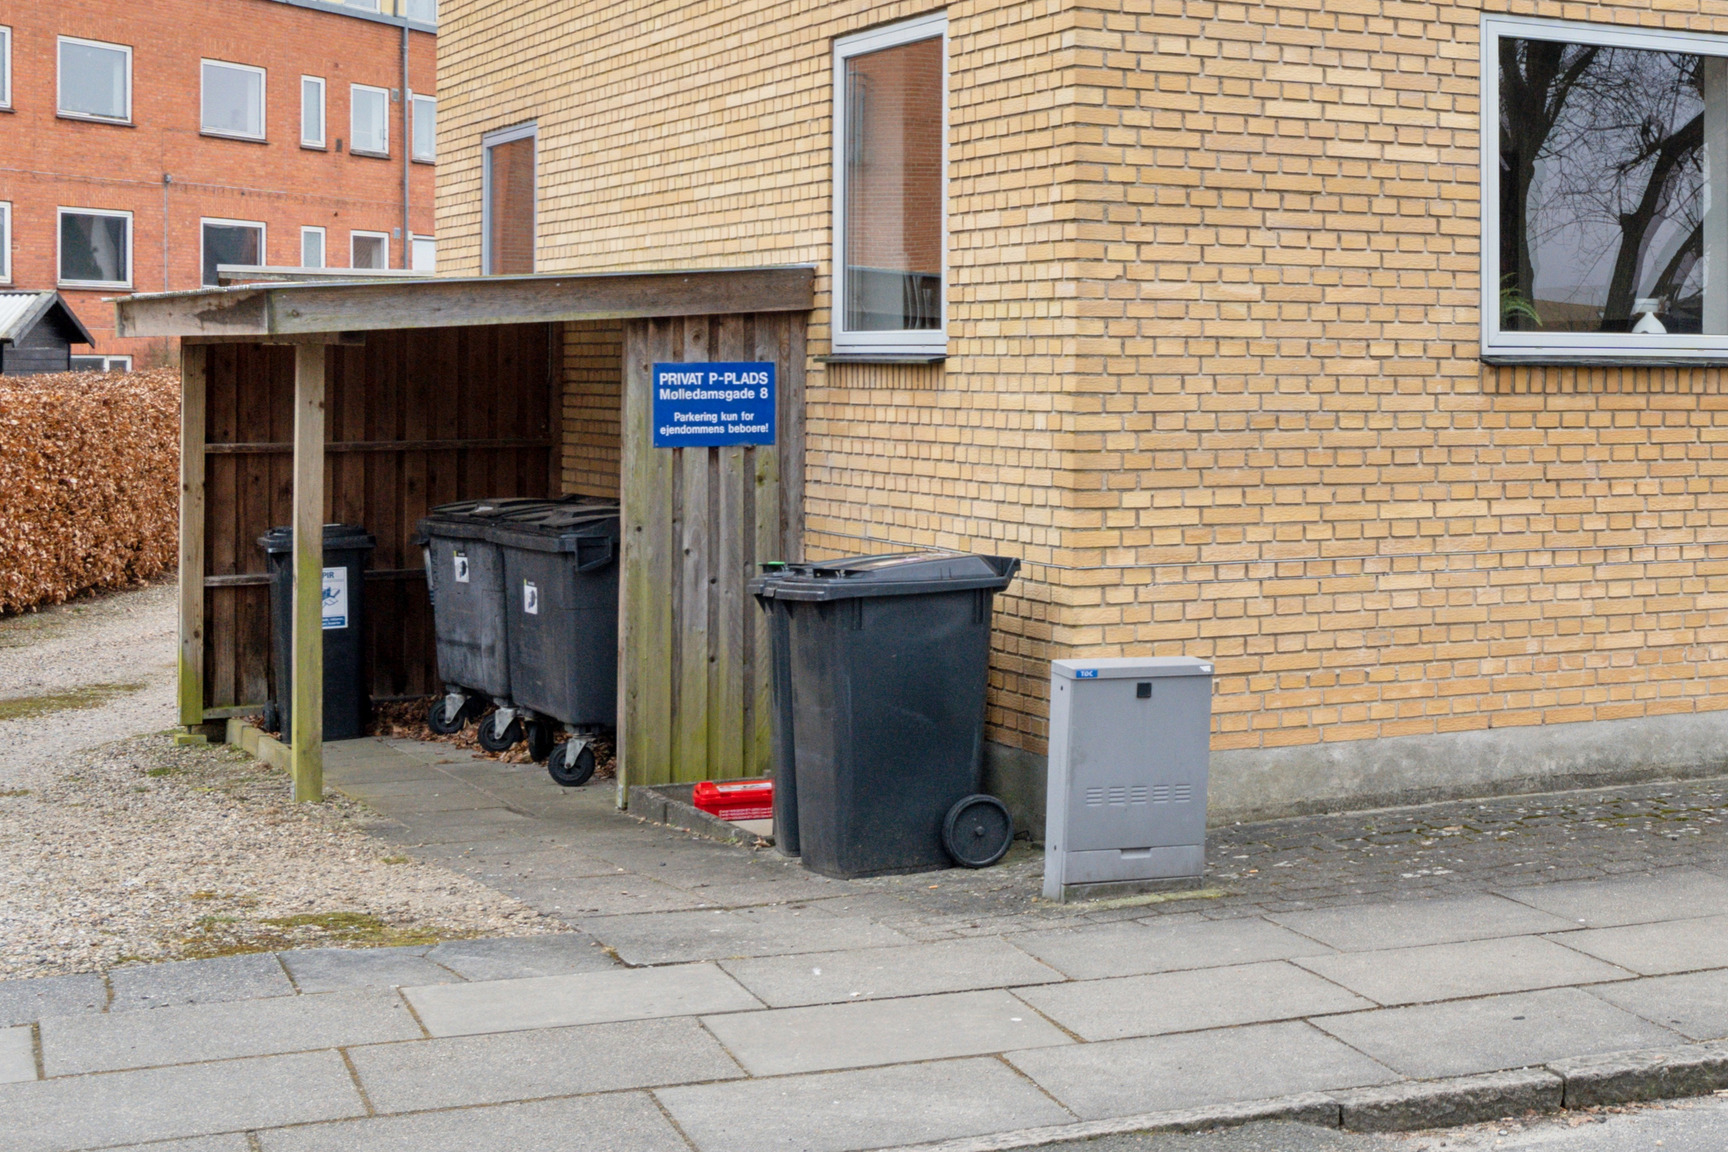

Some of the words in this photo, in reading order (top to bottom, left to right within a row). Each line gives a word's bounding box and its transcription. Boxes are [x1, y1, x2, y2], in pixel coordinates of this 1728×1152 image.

[659, 372, 704, 385] PRIVAT
[709, 371, 769, 385] P-PLADS
[659, 388, 755, 401] Mølledamsgade
[759, 387, 769, 399] 8
[674, 412, 718, 423] Parkering
[721, 411, 738, 421] kun
[741, 411, 755, 421] for
[660, 424, 725, 436] ejendommens
[728, 423, 769, 433] beboere!
